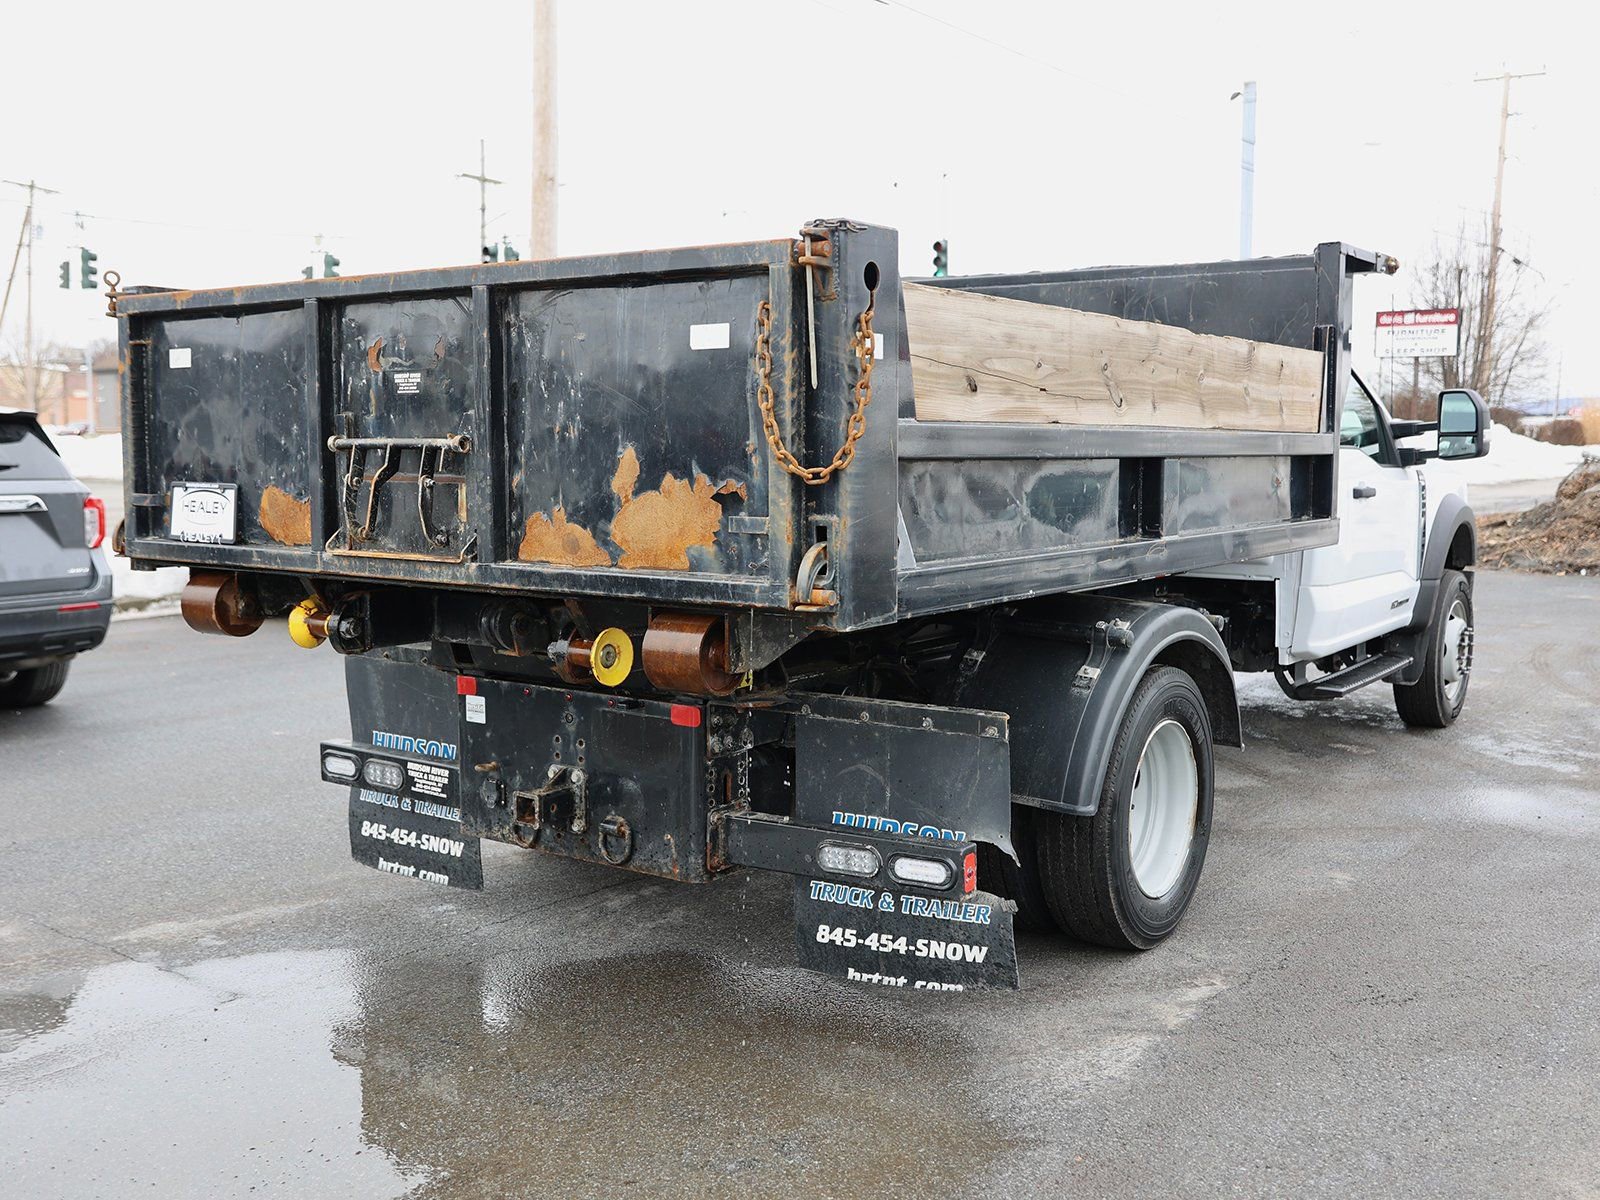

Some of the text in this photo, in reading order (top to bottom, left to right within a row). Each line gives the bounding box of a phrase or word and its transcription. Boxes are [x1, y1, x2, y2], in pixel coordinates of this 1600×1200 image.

[182, 499, 227, 514] HEALEY
[360, 788, 399, 808] TRUCK
[401, 797, 411, 811] &
[414, 799, 461, 822] TRAILE
[361, 820, 465, 858] 845-454-SNOW
[810, 880, 992, 925] TRUCK & TRAILER
[816, 924, 988, 964] 845-454-SNOW
